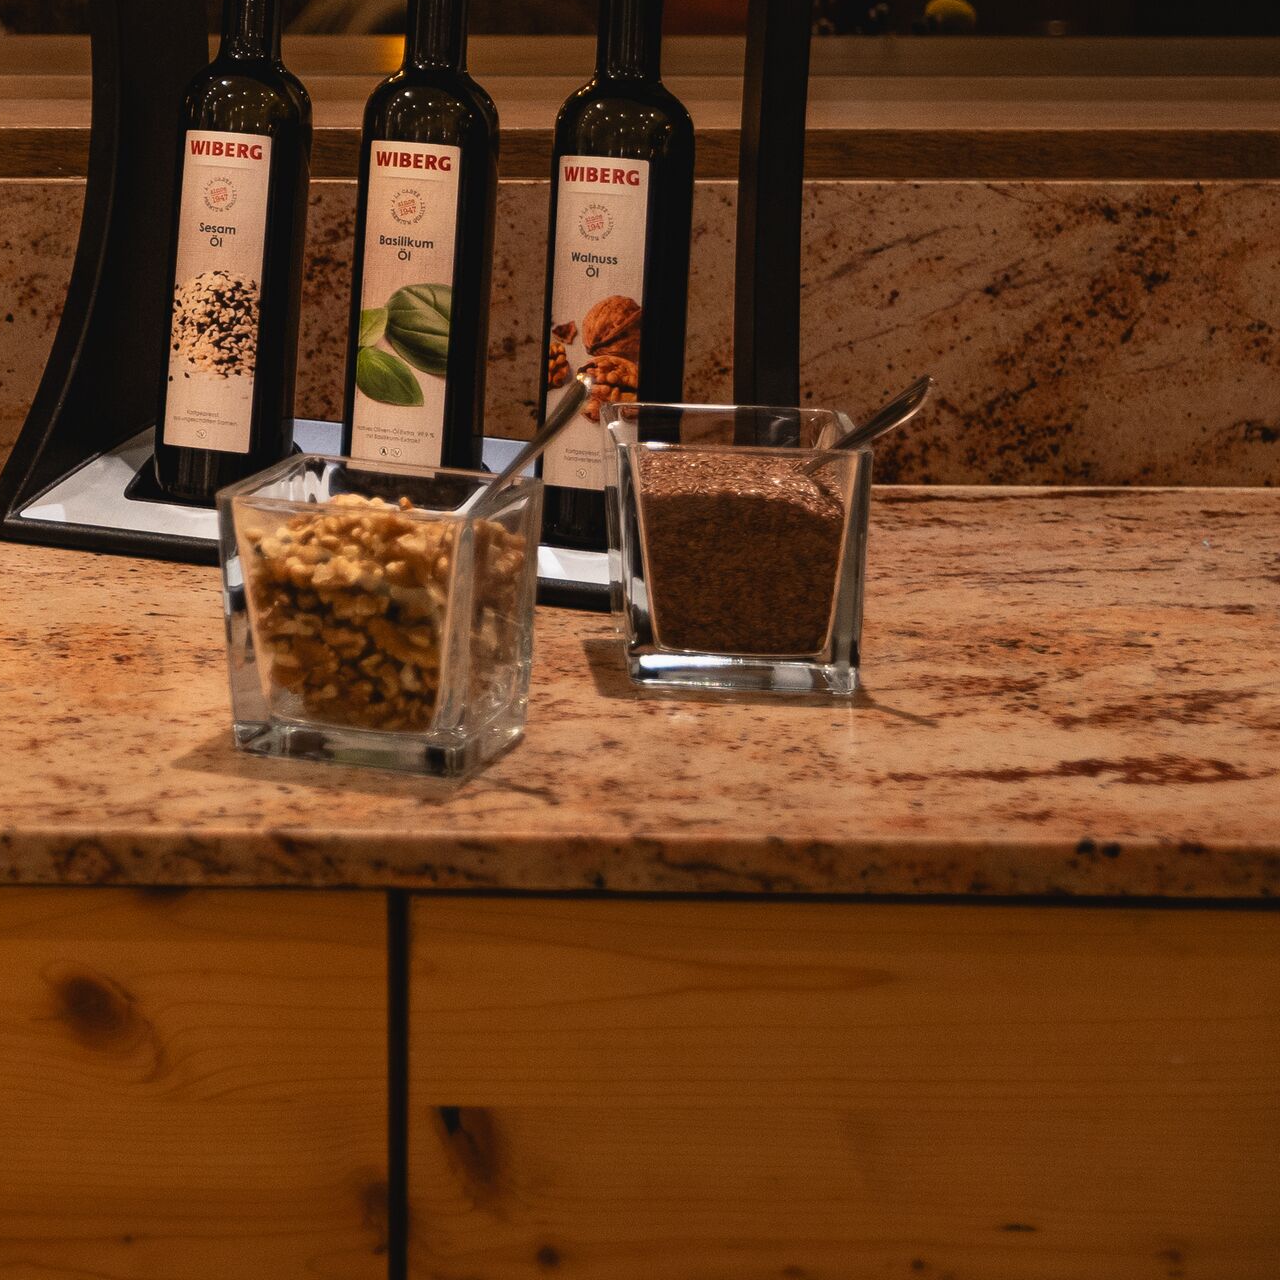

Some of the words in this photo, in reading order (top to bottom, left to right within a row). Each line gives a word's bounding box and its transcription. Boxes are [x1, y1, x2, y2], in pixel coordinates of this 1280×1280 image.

[190, 140, 263, 160] WIBERG
[376, 151, 451, 171] WIBERG
[564, 166, 640, 186] WIBERG
[199, 222, 236, 235] Sesam
[209, 235, 223, 248] Öl
[379, 235, 434, 249] Basilikum
[397, 248, 411, 261] Öl
[571, 252, 618, 265] Walnuss
[585, 265, 599, 278] Öl
